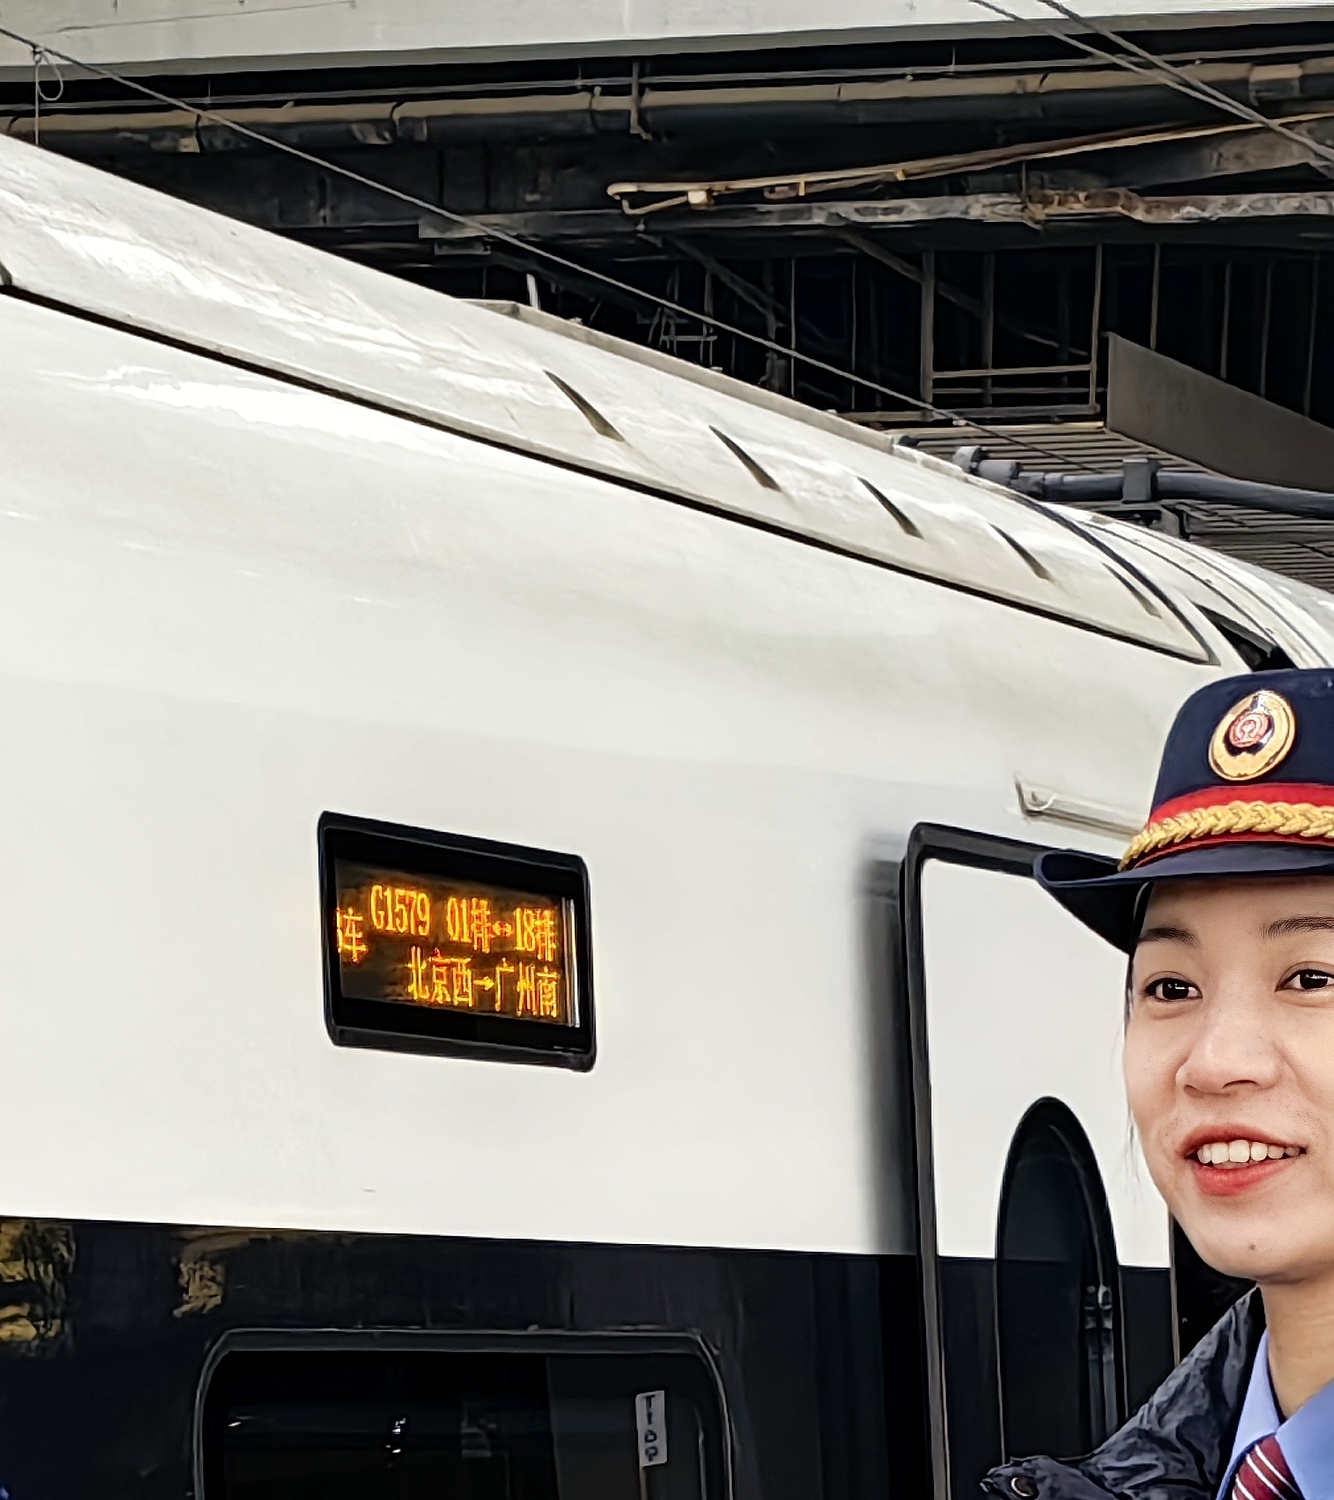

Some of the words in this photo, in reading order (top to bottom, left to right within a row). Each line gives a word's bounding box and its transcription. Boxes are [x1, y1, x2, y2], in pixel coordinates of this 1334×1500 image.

[336, 905, 367, 963] 车
[370, 884, 431, 937] G1579
[407, 945, 473, 1008] 北京西
[494, 956, 560, 1018] 广州南
